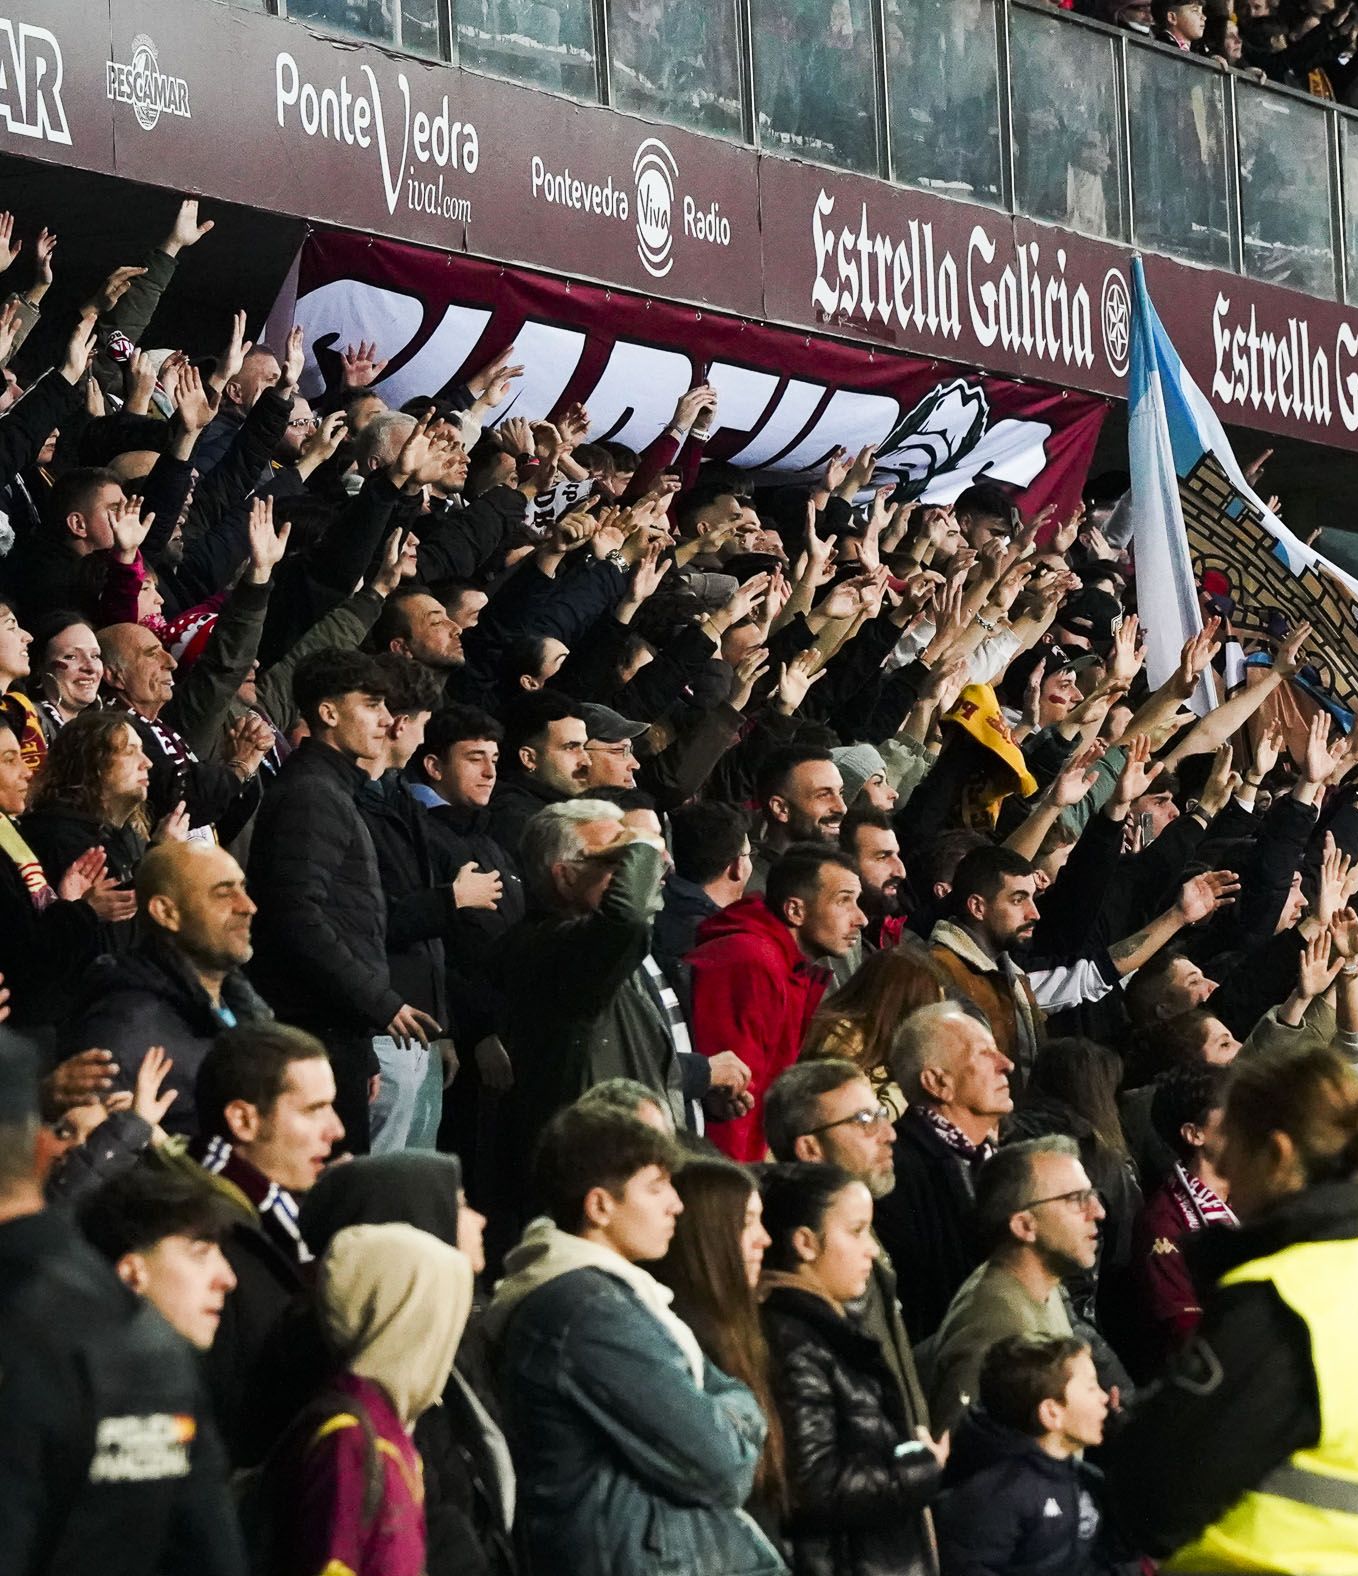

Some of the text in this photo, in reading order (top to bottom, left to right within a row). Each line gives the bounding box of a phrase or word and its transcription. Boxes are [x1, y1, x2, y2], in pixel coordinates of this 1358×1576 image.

[106, 60, 192, 118] PESCAMAR
[531, 155, 629, 221] Pontevedra
[684, 197, 731, 247] Radio
[811, 188, 1095, 370] Estrella Galicia
[1211, 290, 1333, 427] Estrella
